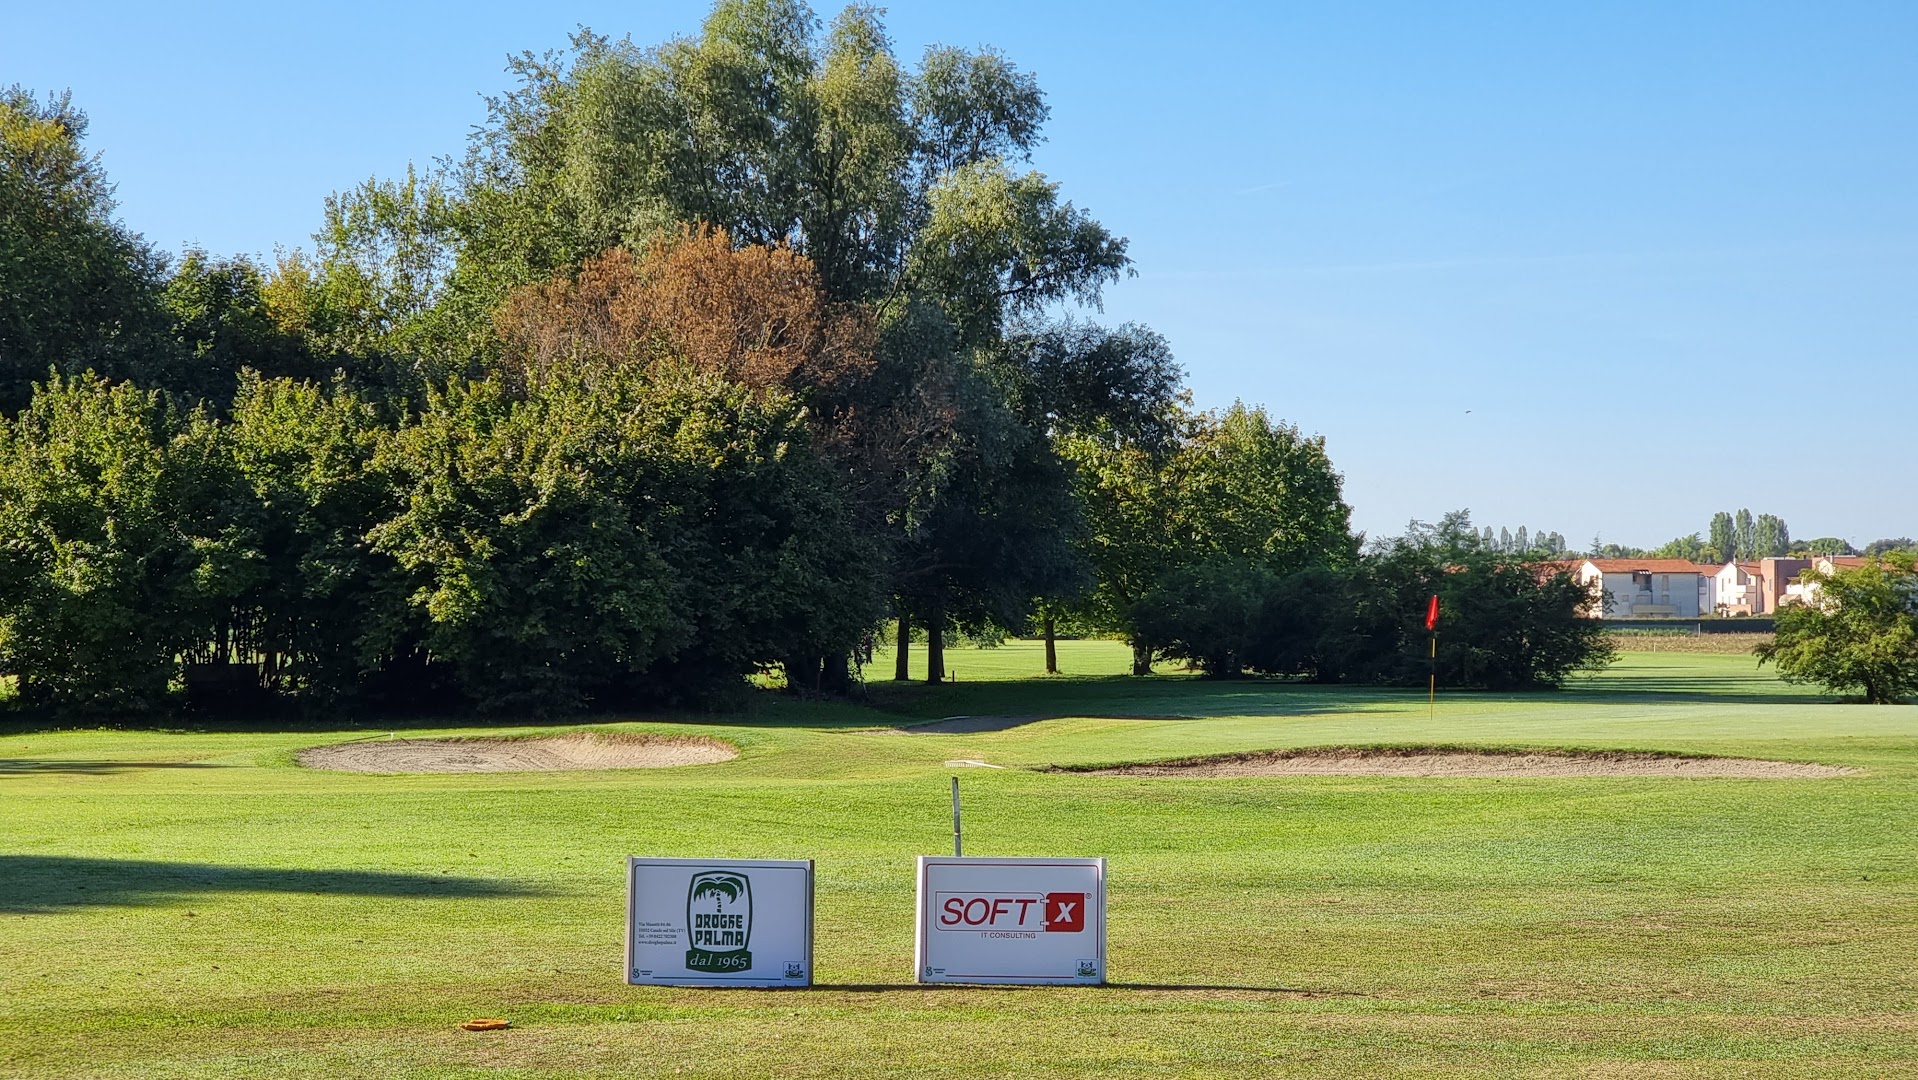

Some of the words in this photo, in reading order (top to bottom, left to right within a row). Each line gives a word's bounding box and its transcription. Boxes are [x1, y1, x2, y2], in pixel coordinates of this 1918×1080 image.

[940, 897, 1037, 926] SOFT
[1054, 902, 1077, 923] X
[695, 914, 743, 929] DROGHE
[695, 930, 744, 946] PALMA
[690, 953, 714, 966] dal
[717, 954, 748, 969] 1965
